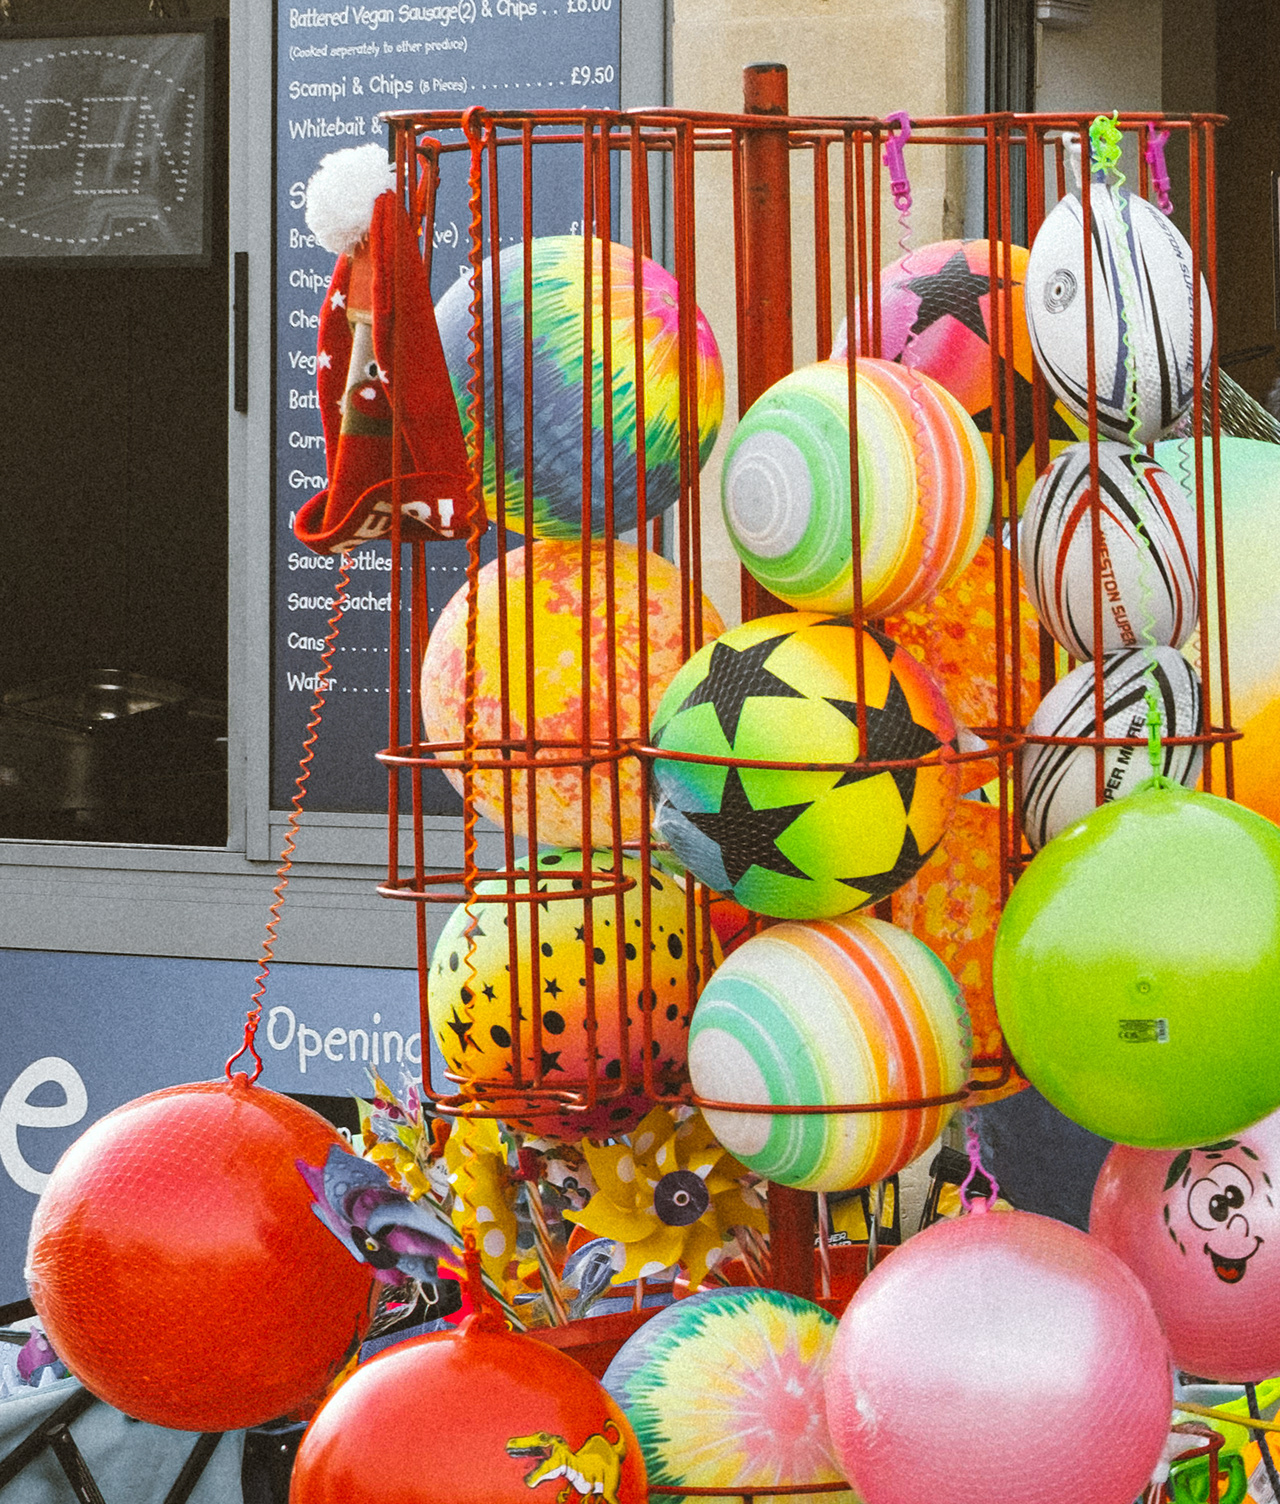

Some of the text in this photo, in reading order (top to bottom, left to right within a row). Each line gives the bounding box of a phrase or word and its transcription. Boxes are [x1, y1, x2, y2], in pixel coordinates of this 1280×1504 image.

[290, 5, 349, 29] Battered
[352, 5, 395, 30] Vegan
[481, 1, 493, 18] &
[496, 0, 538, 21] Chips
[289, 44, 328, 61] (Cooked
[383, 41, 394, 54] to
[396, 40, 423, 53] other
[425, 36, 468, 55] produce)
[288, 75, 347, 102] Scampi
[352, 76, 364, 96] &
[369, 73, 414, 99] Chips
[571, 64, 614, 86] £9.50
[289, 117, 383, 139] Whitebait &
[290, 269, 332, 294] Chips
[288, 470, 329, 489] Grav
[288, 552, 334, 571] Sauce
[288, 591, 401, 612] Sauce Sachet
[1112, 605, 1138, 647] SUPER
[288, 632, 325, 651] Cans
[287, 672, 337, 692] Water
